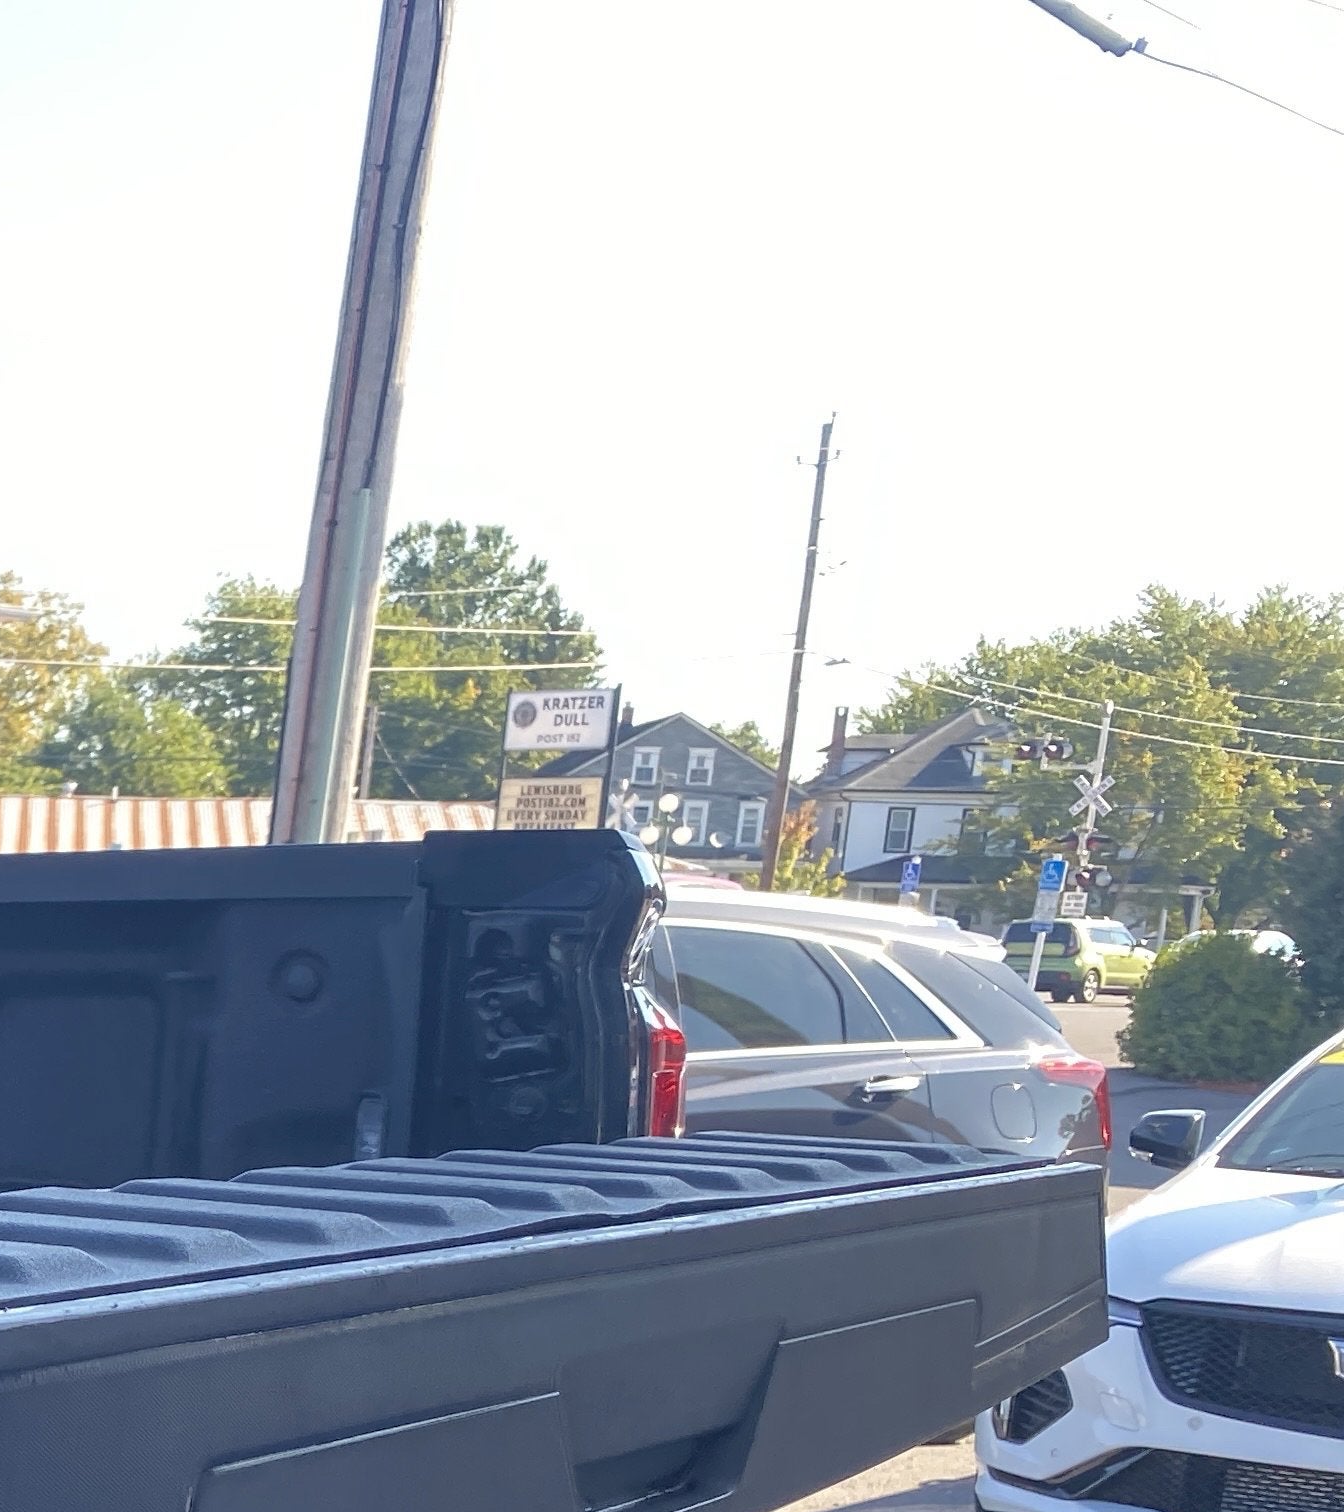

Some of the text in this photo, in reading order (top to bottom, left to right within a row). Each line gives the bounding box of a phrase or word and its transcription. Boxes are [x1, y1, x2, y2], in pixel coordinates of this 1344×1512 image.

[542, 695, 605, 711] KRATZER
[553, 713, 589, 727] DULL
[536, 733, 564, 744] POST
[520, 784, 582, 797] LEWISBURG
[516, 797, 587, 809] POST182.COM
[506, 809, 587, 821] EVERY SUNDAY
